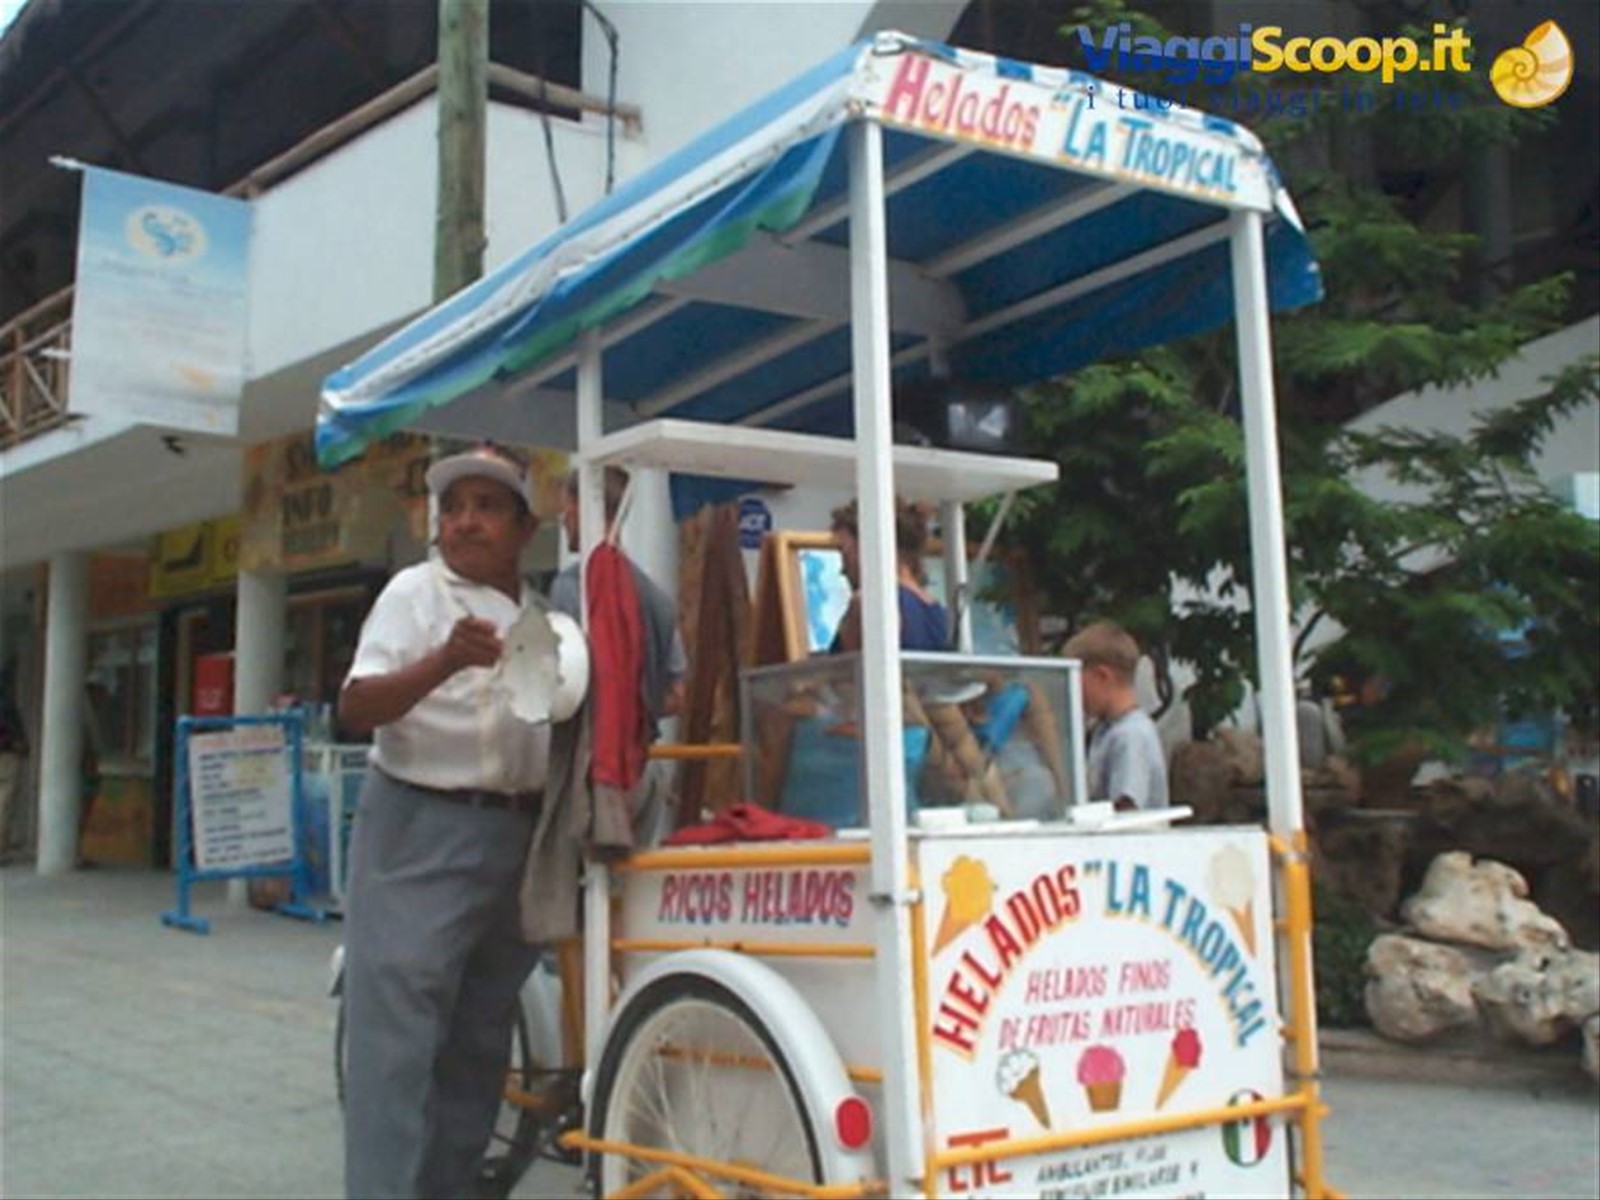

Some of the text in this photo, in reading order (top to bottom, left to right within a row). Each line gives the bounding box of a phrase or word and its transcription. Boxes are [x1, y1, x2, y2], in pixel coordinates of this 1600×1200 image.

[884, 53, 1041, 148] Helados
[1118, 116, 1238, 193] TROPICAL
[657, 869, 856, 928] RICOS HELADOS
[933, 863, 1082, 1055] HELADOS
[1163, 877, 1268, 1049] TROPICAL
[1025, 959, 1173, 1005] HELADOS FINOS
[998, 999, 1197, 1049] DE FRUTAS NATURALES
